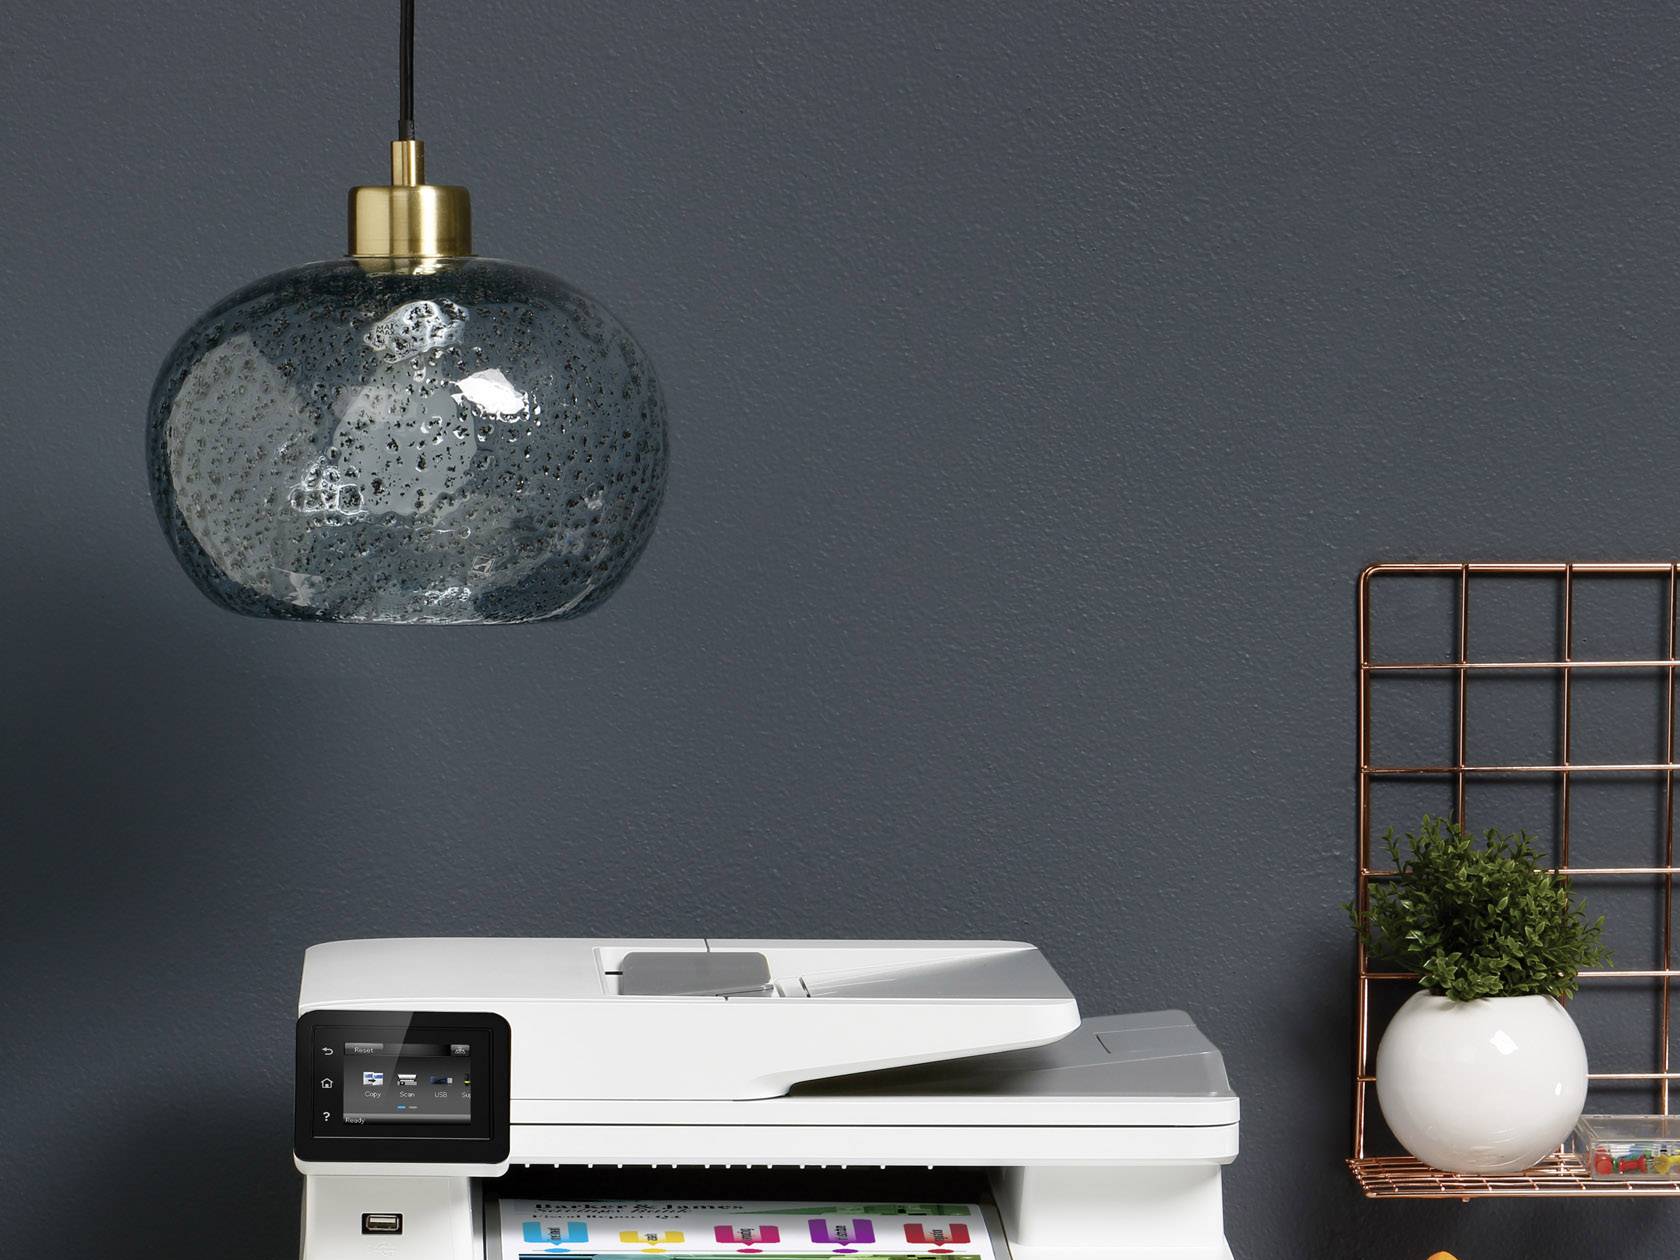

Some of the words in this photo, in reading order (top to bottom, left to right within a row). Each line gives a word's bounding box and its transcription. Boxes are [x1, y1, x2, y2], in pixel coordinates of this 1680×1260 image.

[354, 1046, 374, 1054] Reset
[365, 1091, 381, 1099] Copy
[345, 1117, 365, 1125] Ready
